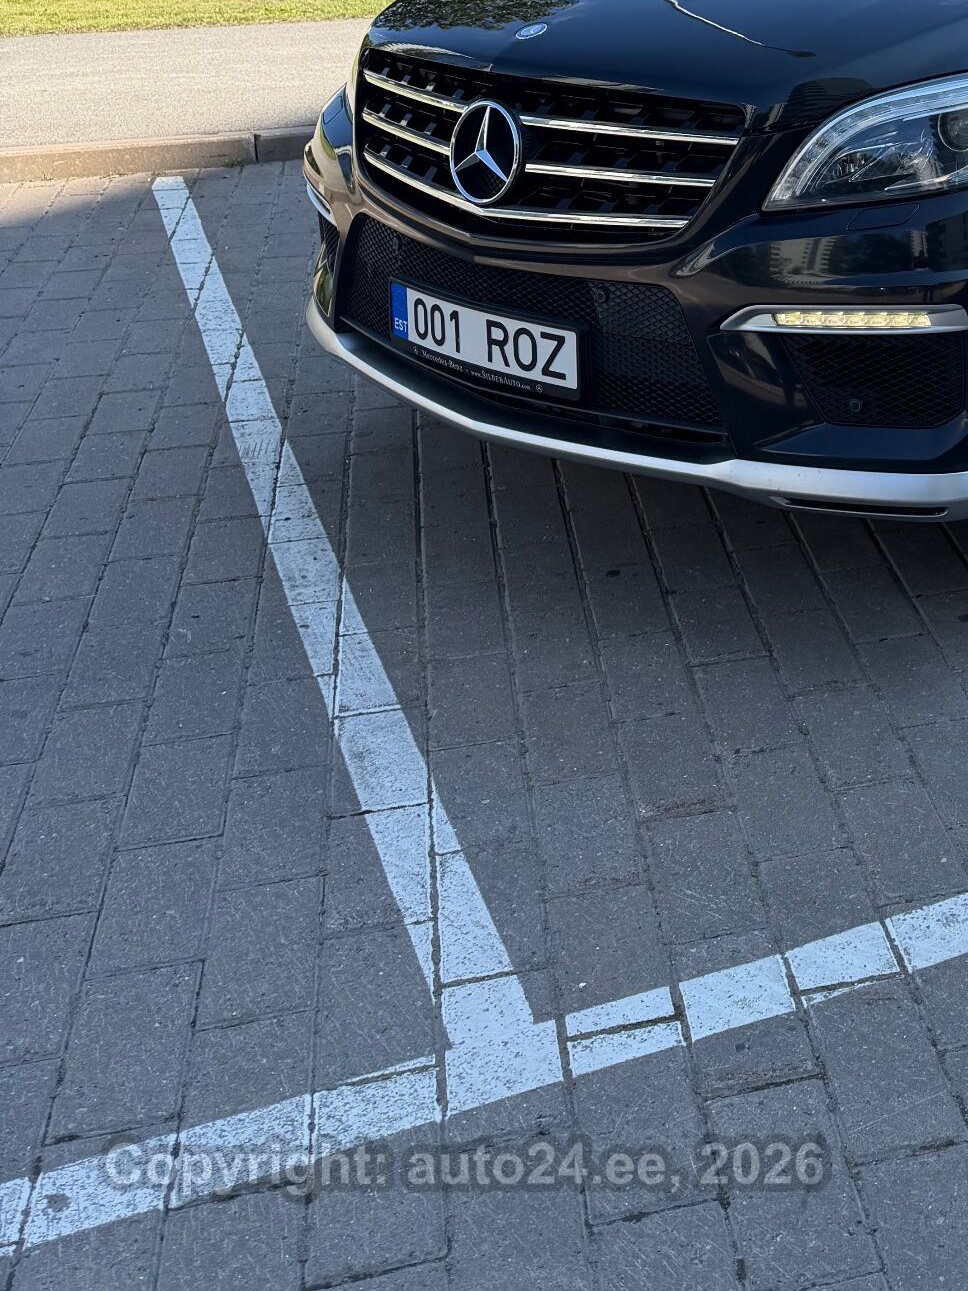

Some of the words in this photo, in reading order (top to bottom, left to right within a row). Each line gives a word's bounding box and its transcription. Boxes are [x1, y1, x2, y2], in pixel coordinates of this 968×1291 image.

[394, 317, 408, 333] EST
[413, 298, 461, 353] 001
[485, 318, 567, 381] ROZ
